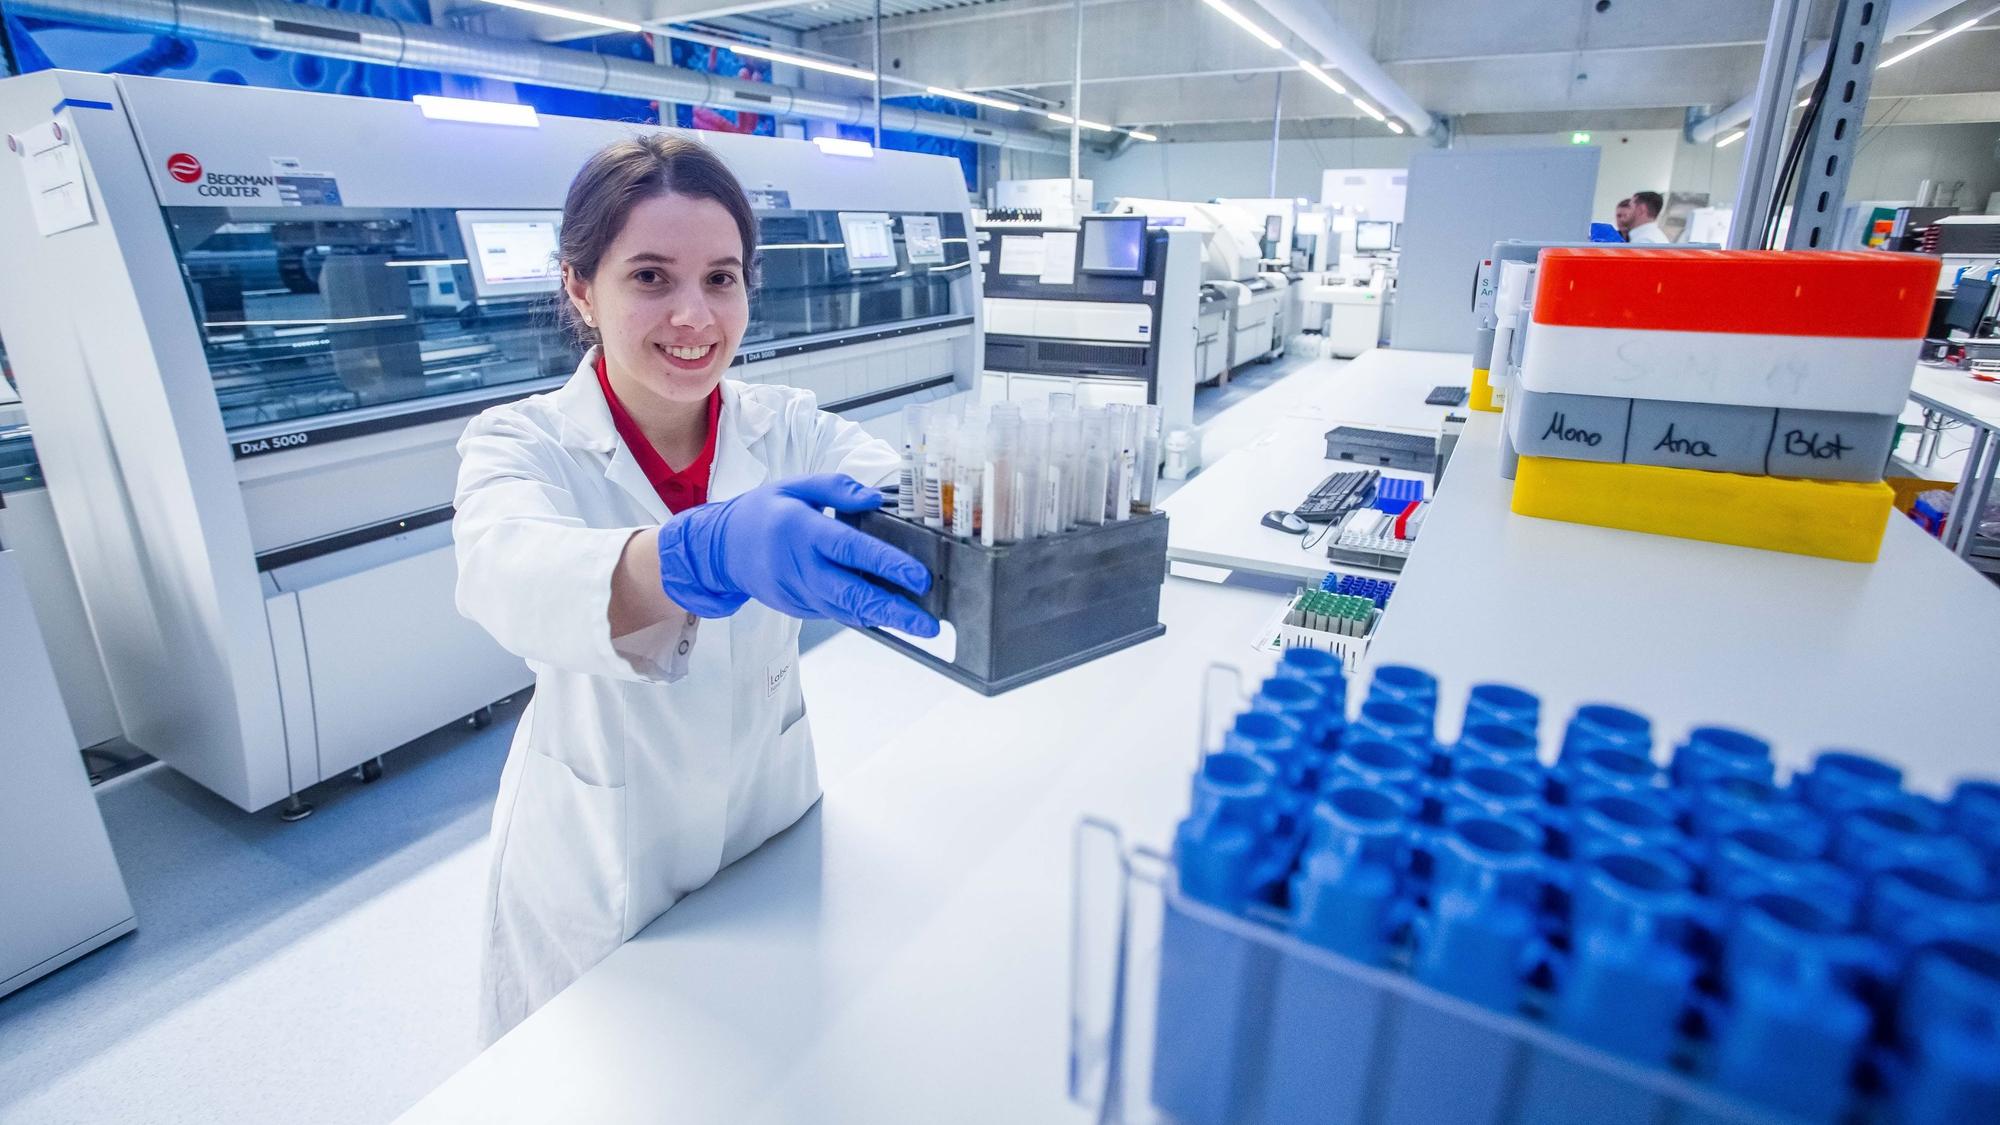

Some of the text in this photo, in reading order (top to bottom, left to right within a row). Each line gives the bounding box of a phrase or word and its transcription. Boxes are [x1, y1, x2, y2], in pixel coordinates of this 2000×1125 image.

[198, 184, 261, 198] COULTER
[206, 173, 274, 186] BECKMAN
[1541, 411, 1602, 447] Mono
[1654, 422, 1717, 457] Ana
[240, 433, 308, 454] DxA 5000
[1784, 429, 1853, 460] Blot
